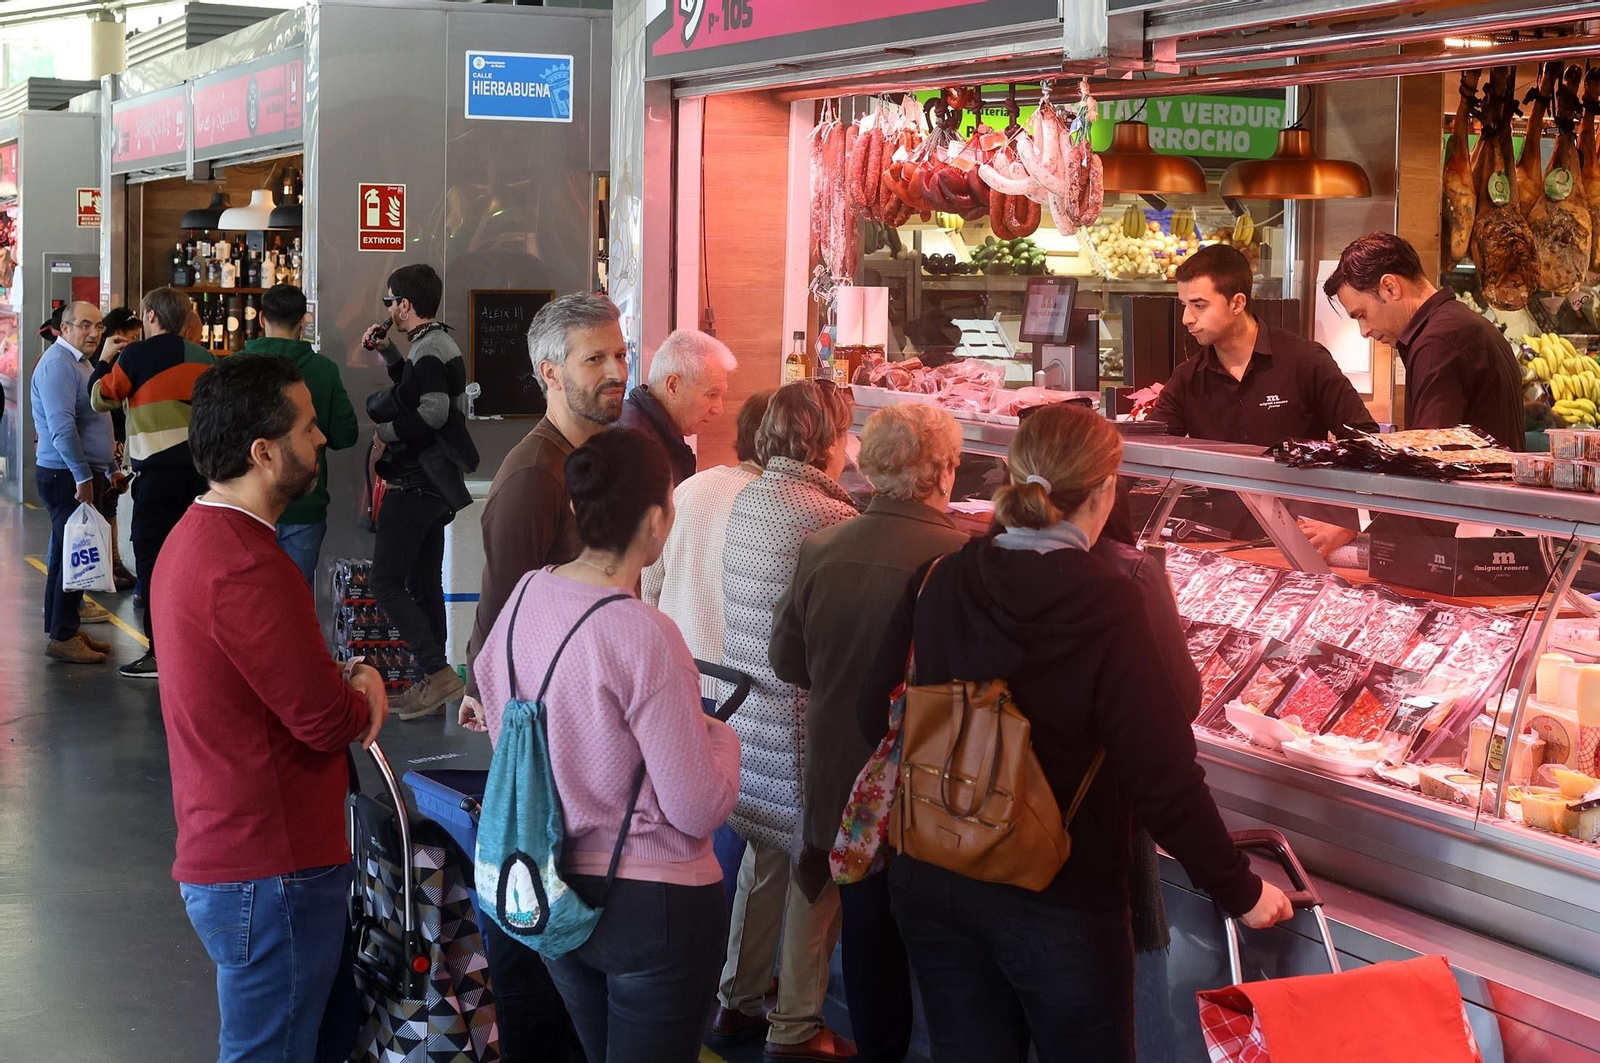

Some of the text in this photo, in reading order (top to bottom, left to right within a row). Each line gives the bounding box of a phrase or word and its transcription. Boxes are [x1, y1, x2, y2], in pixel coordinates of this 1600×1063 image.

[722, 0, 753, 31] 105
[472, 80, 551, 98] HIERBABUENA
[1097, 100, 1287, 129] TAS Y VERDUR
[362, 236, 402, 245] EXTINTOR
[1493, 552, 1516, 564] m
